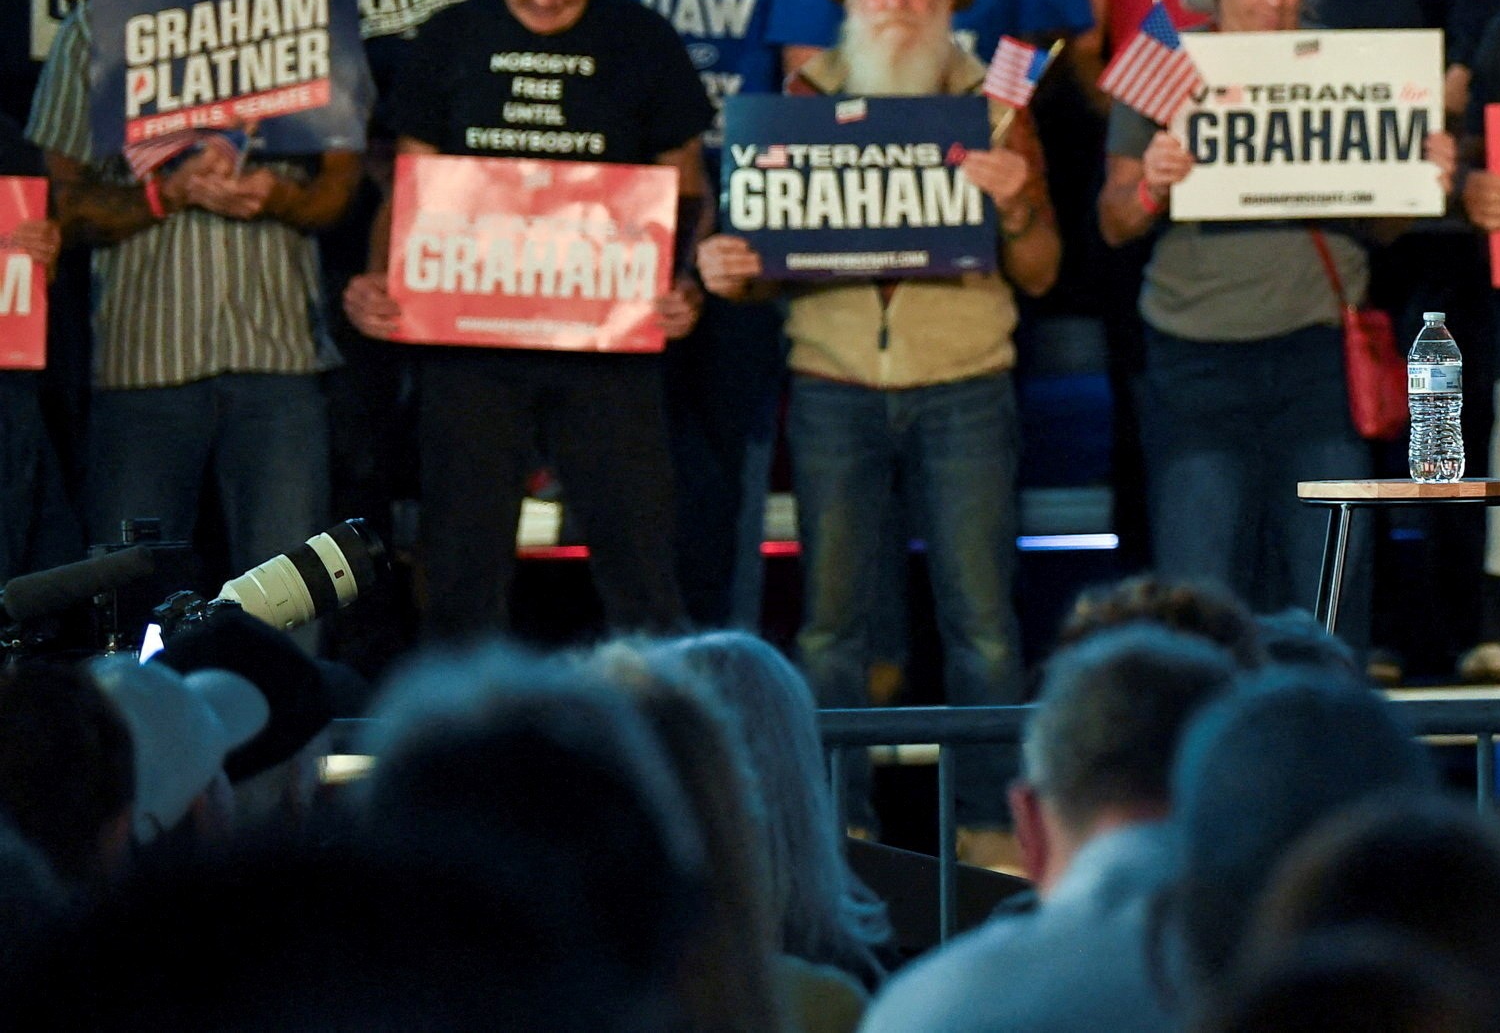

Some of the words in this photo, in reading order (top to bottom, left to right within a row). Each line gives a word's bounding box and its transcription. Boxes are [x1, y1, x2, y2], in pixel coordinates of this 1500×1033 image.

[125, 28, 330, 119] PLATNER
[490, 51, 596, 77] NOBODY'S
[511, 75, 564, 101] FREE
[502, 101, 567, 126] UNTIL
[465, 127, 606, 155] EVERYBODY'S
[1189, 107, 1429, 165] GRAHAM
[729, 166, 985, 230] GRAHAM
[405, 233, 659, 301] GRAHAM
